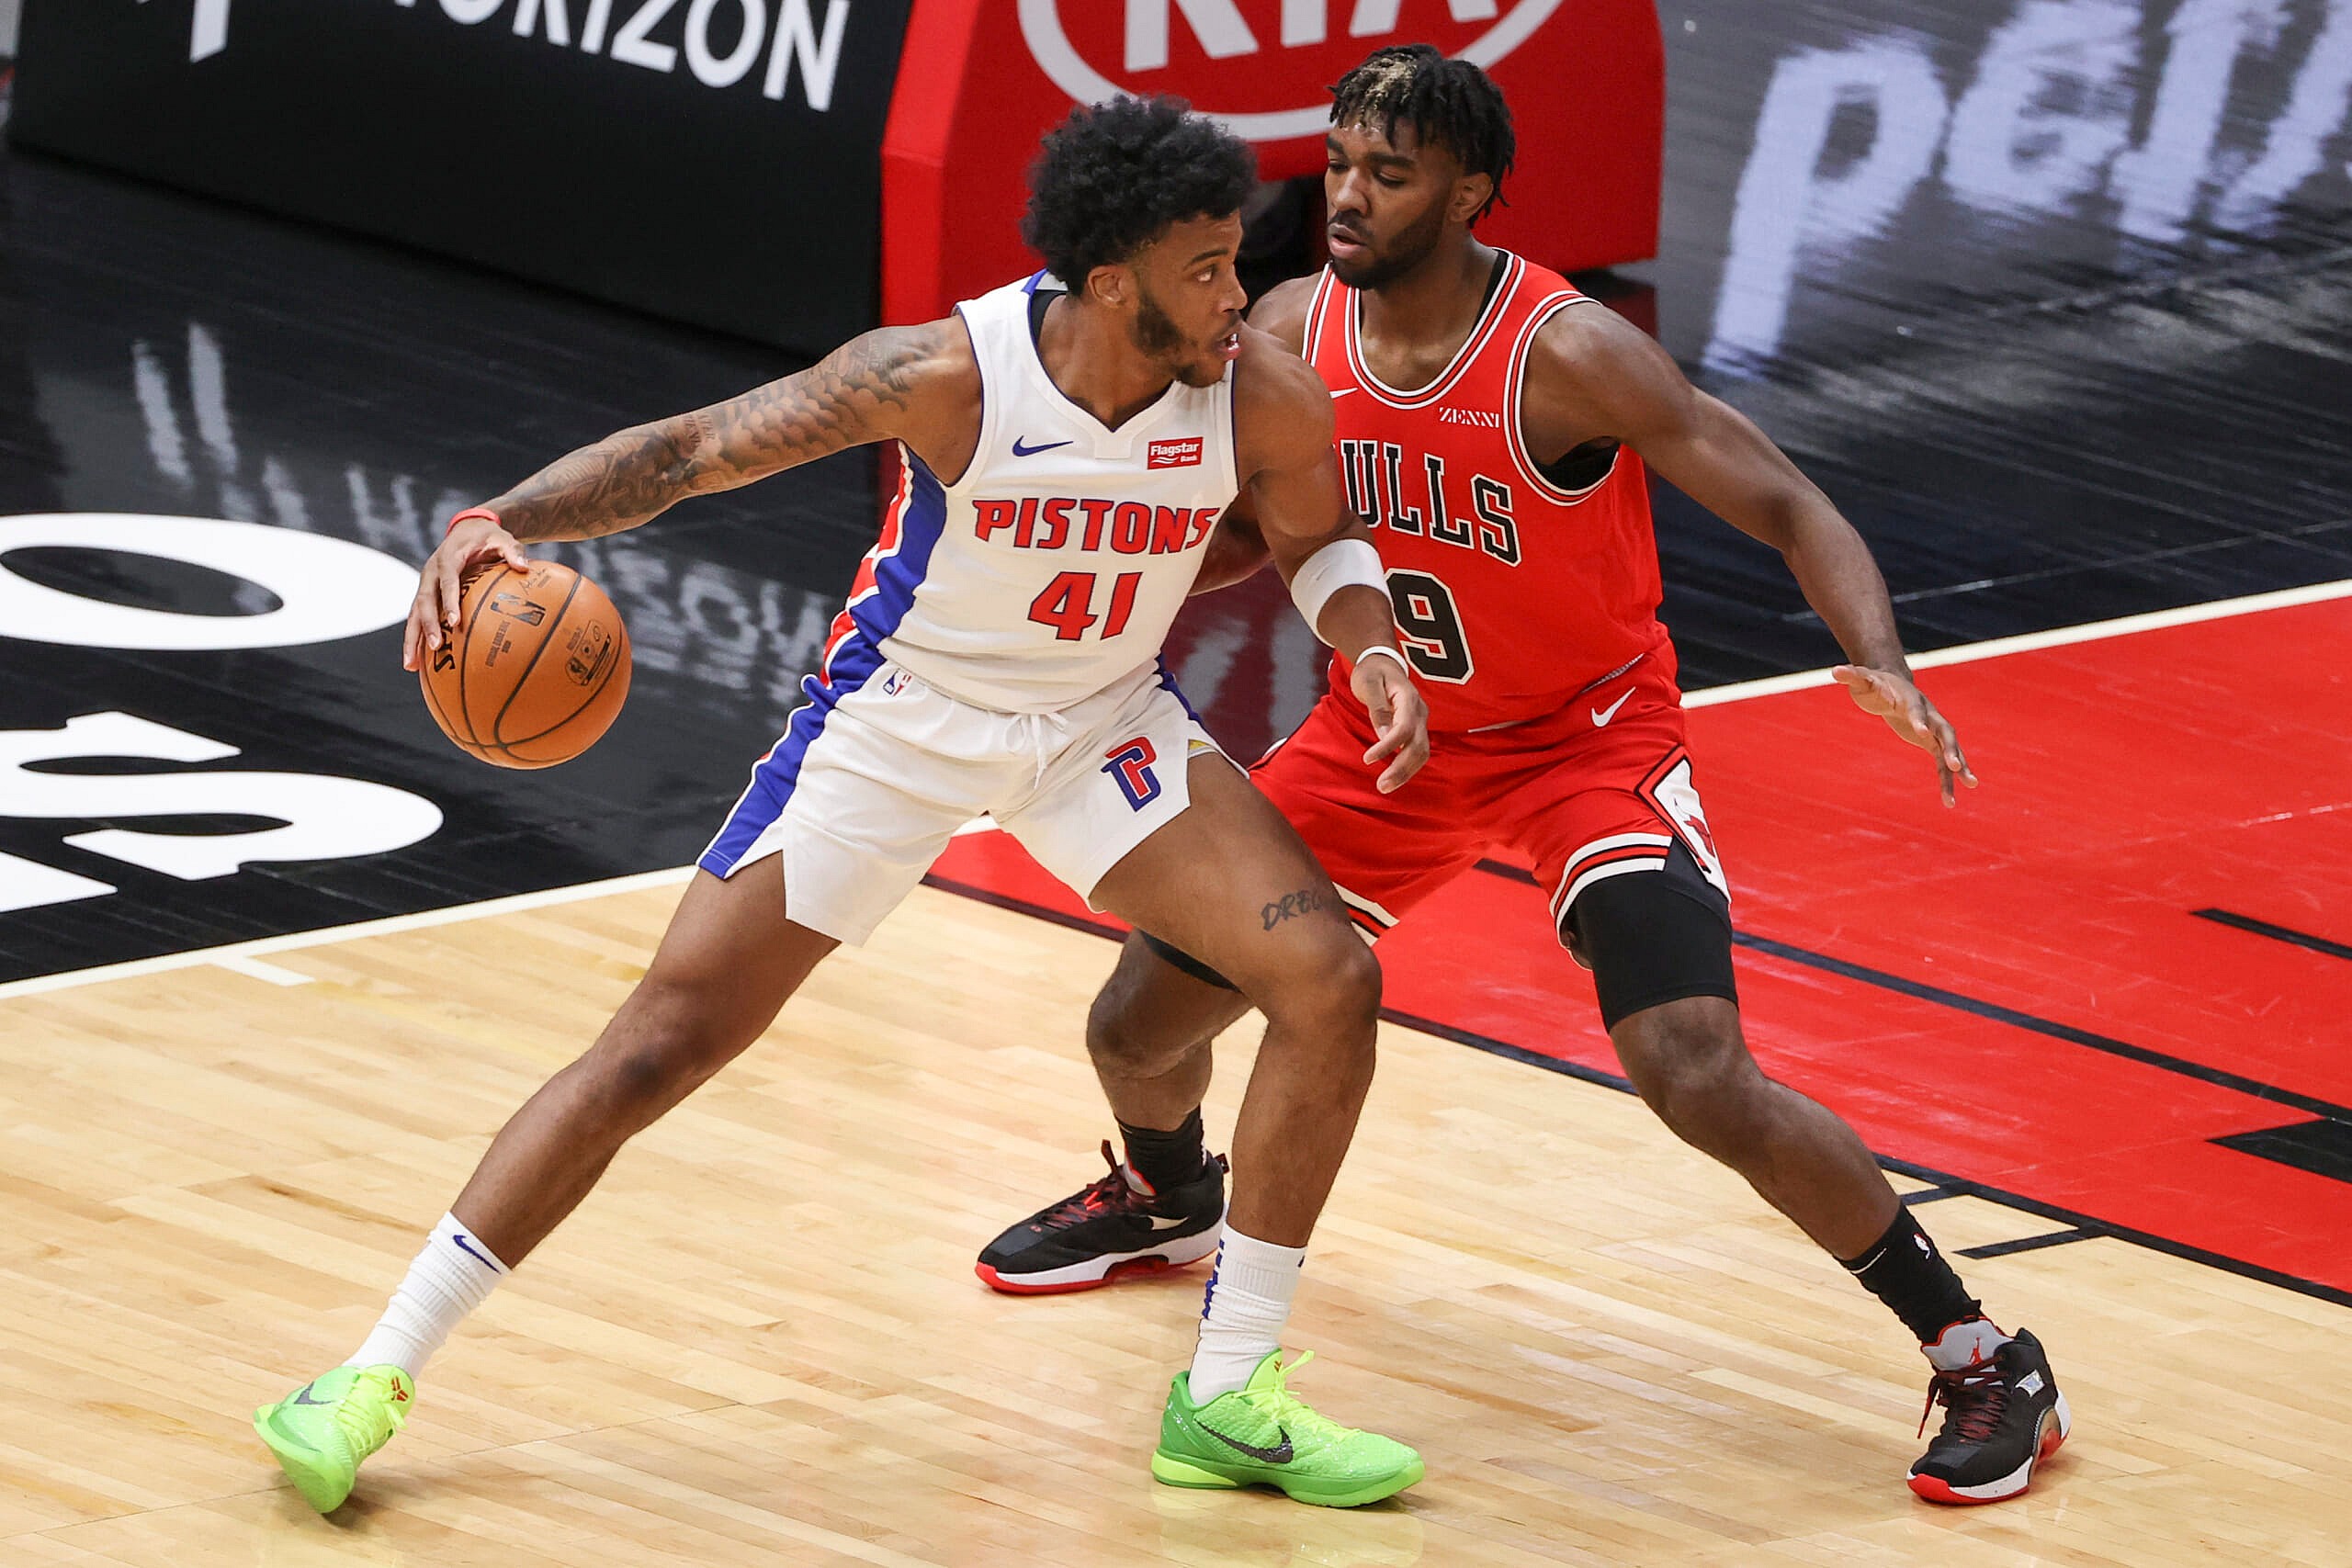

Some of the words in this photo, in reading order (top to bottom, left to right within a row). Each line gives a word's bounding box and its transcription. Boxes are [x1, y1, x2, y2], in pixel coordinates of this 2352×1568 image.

[1439, 407, 1499, 428] ZENNI
[1150, 442, 1200, 457] Flagstar
[972, 498, 1220, 555] PISTONS
[1334, 440, 1522, 567] ULLS
[1027, 571, 1144, 641] 41
[1385, 567, 1475, 685] 9
